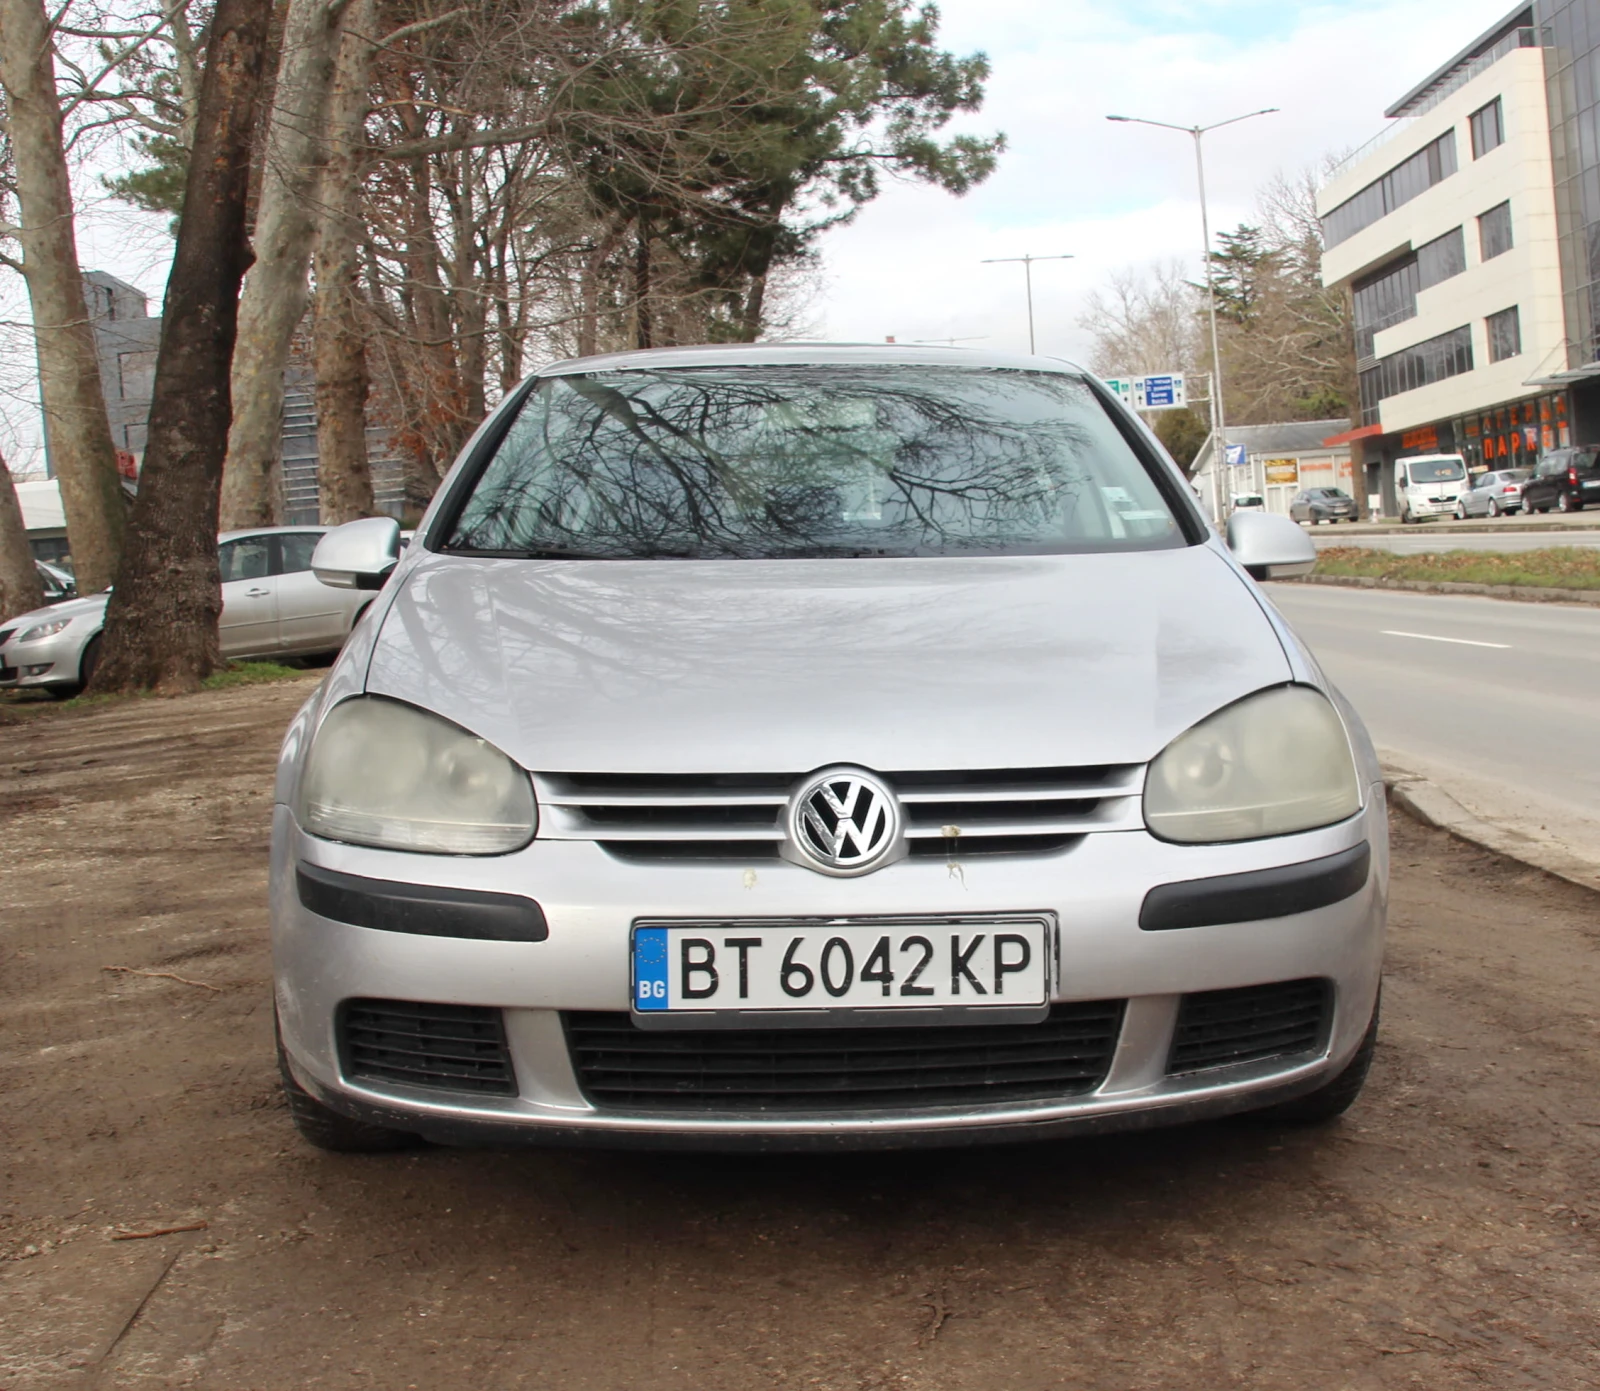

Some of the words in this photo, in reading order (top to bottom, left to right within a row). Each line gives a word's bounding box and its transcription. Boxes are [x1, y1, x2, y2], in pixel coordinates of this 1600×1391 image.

[1483, 421, 1569, 460] ПАРКЕТ
[797, 775, 894, 867] VW
[639, 981, 666, 998] BG
[681, 937, 762, 999] BT
[780, 936, 935, 998] 6042
[950, 933, 1031, 995] KP
